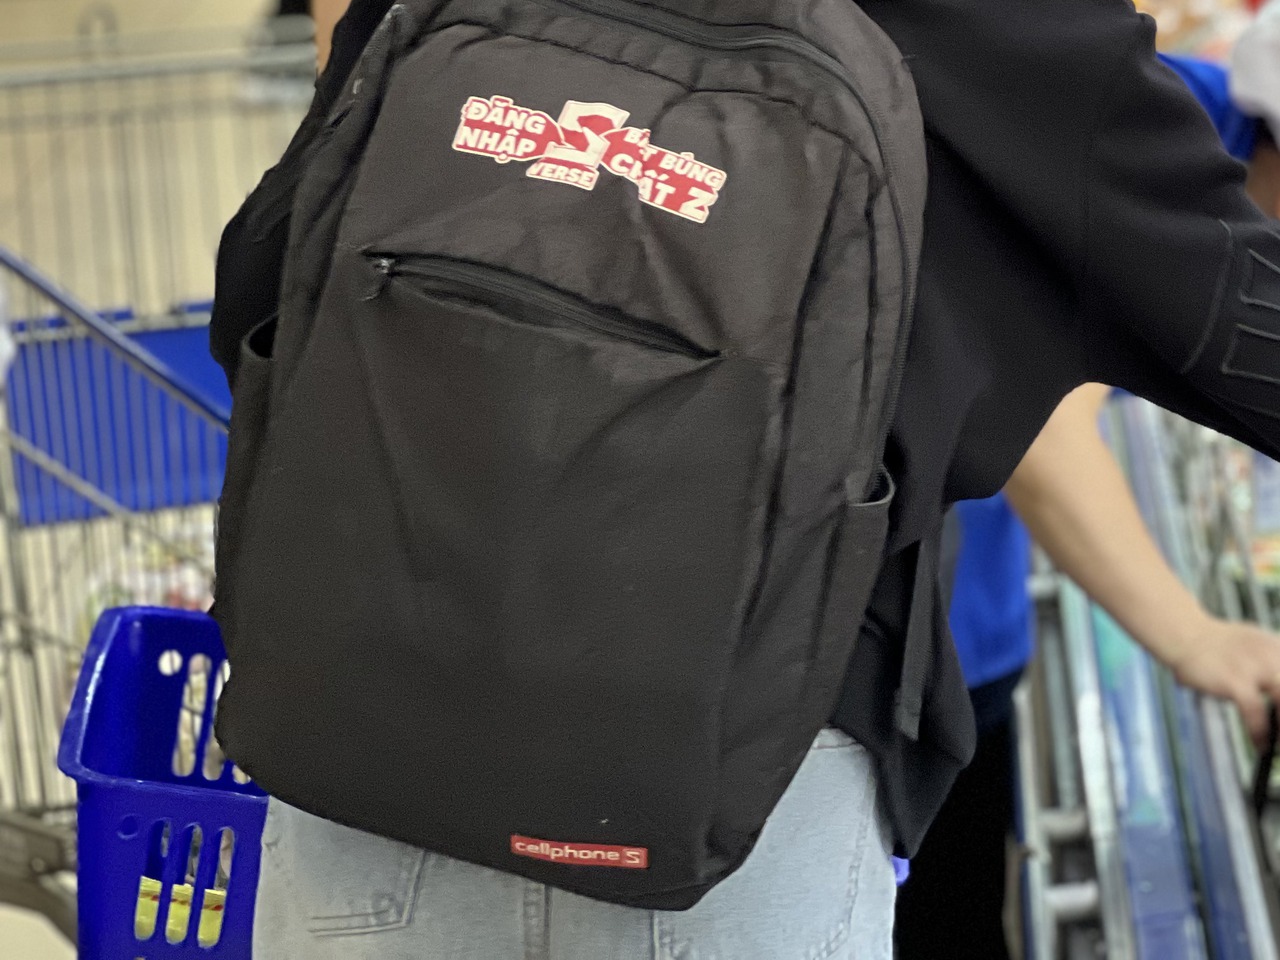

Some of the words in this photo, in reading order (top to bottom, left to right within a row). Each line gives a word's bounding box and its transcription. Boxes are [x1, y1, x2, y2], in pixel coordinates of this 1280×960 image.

[466, 97, 546, 135] ĐĂNG
[459, 126, 537, 162] NHẬP
[533, 160, 594, 187] VERSE
[679, 186, 718, 222] Z
